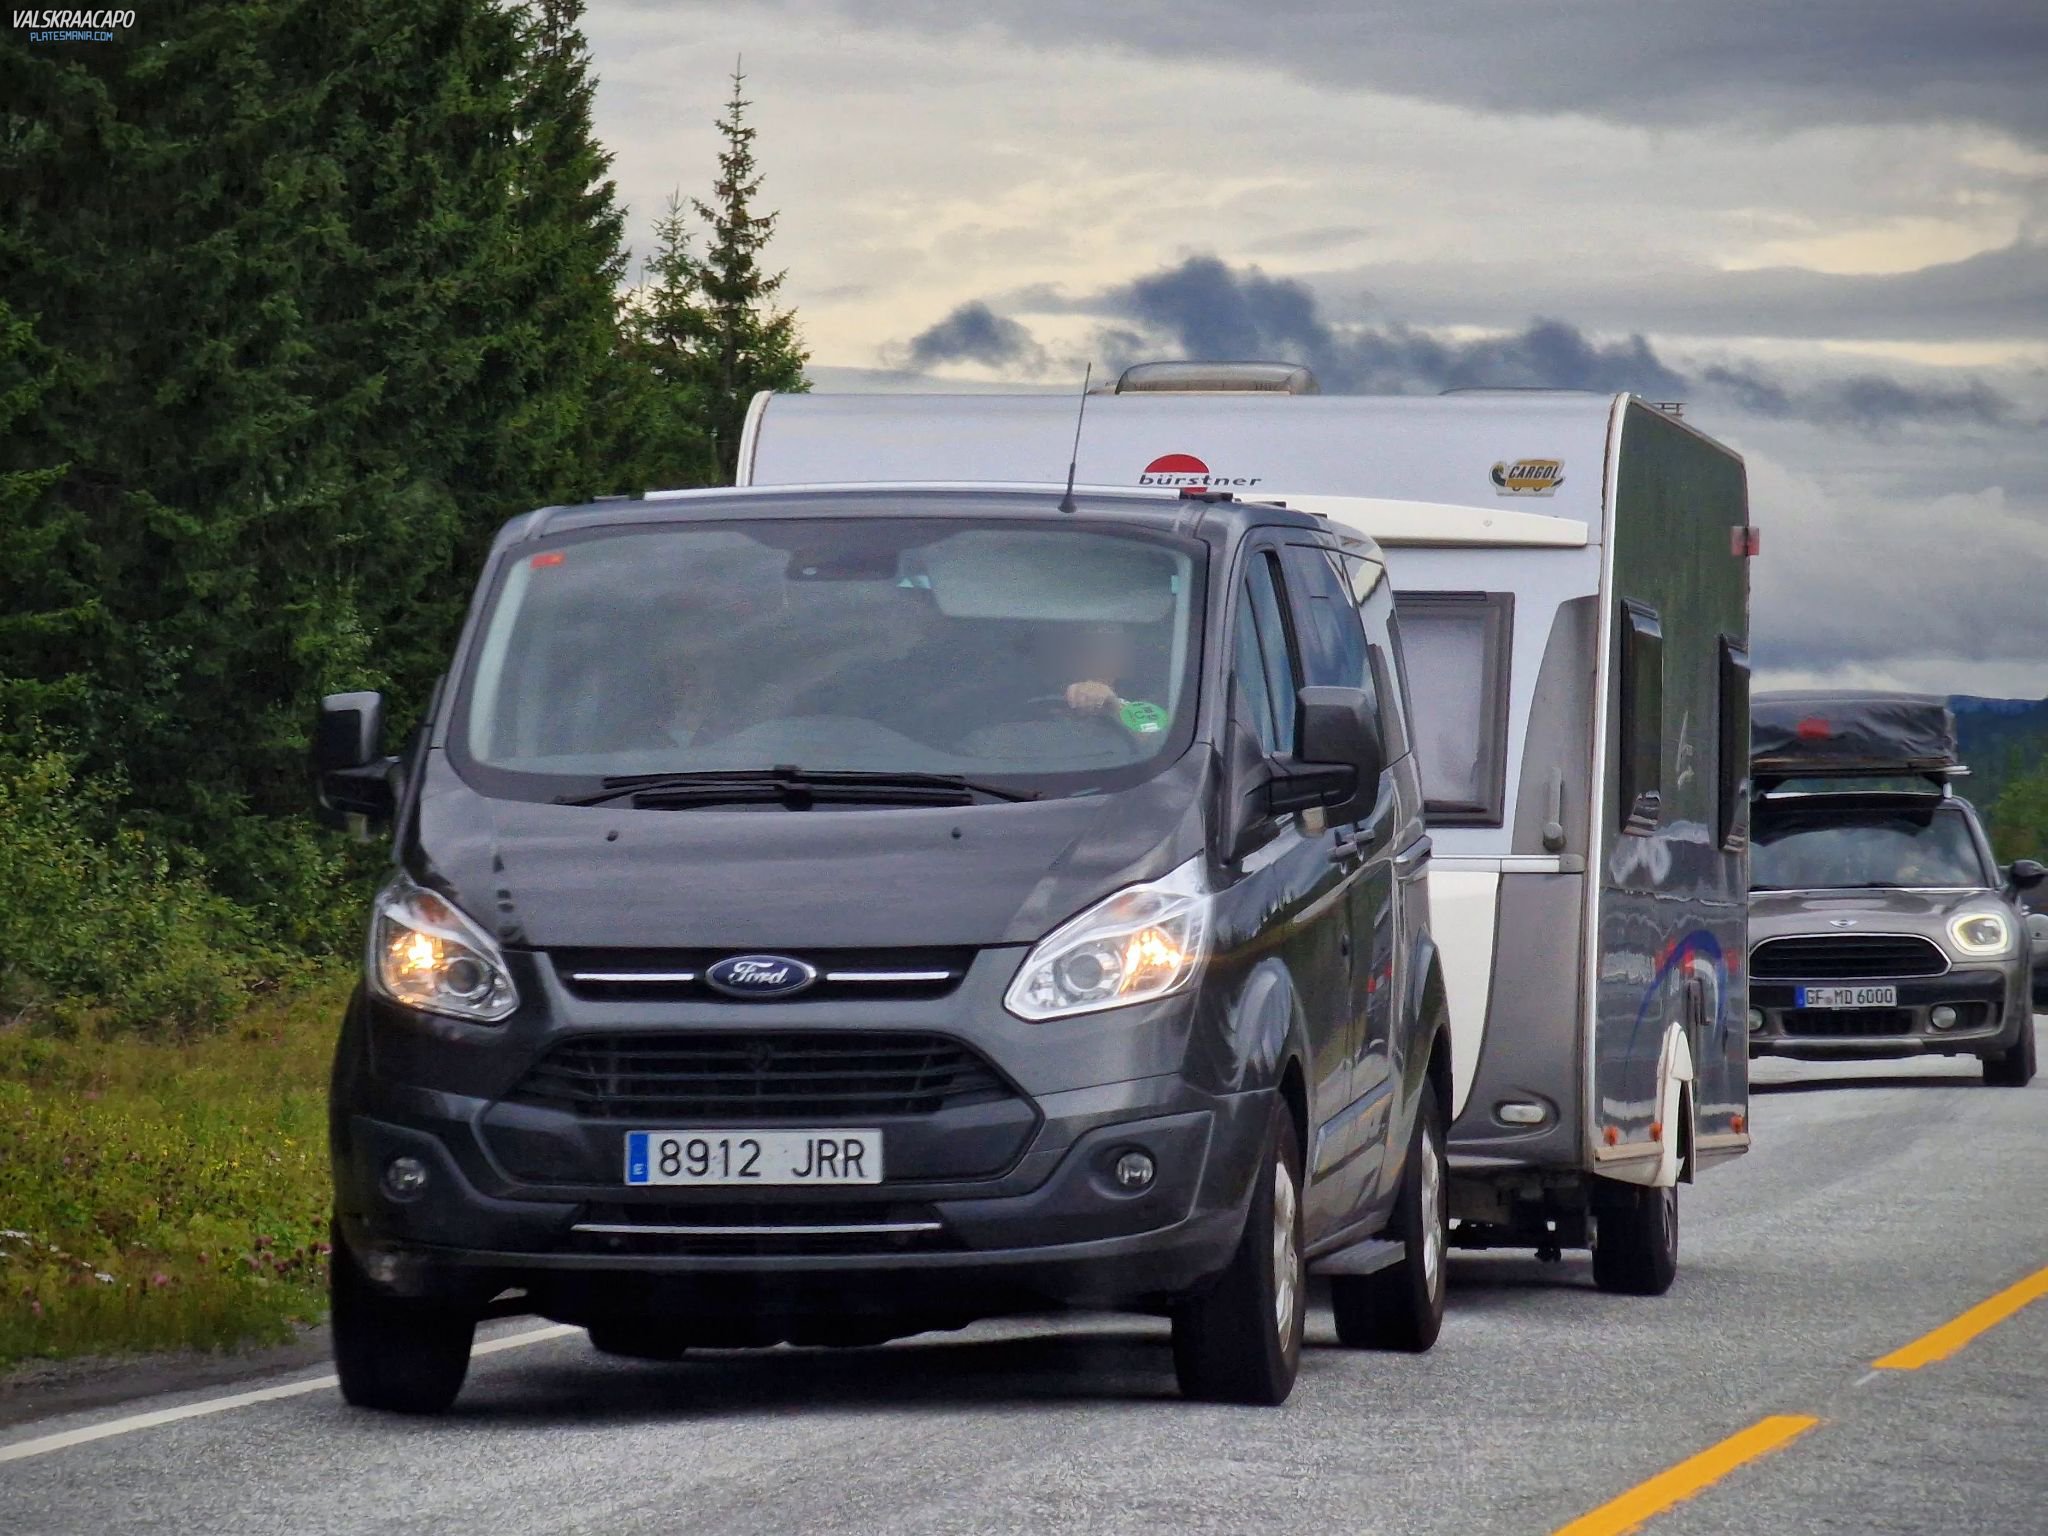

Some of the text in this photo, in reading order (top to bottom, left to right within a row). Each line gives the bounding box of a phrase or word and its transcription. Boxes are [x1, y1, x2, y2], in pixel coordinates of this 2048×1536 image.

[1139, 474, 1262, 486] bürstner
[1508, 465, 1559, 479] CARGOL
[728, 961, 789, 985] Ford
[1806, 989, 1825, 1004] GF
[1834, 989, 1853, 1004] MD
[1857, 988, 1893, 1004] 6000
[659, 1138, 868, 1178] 8912 JRR
